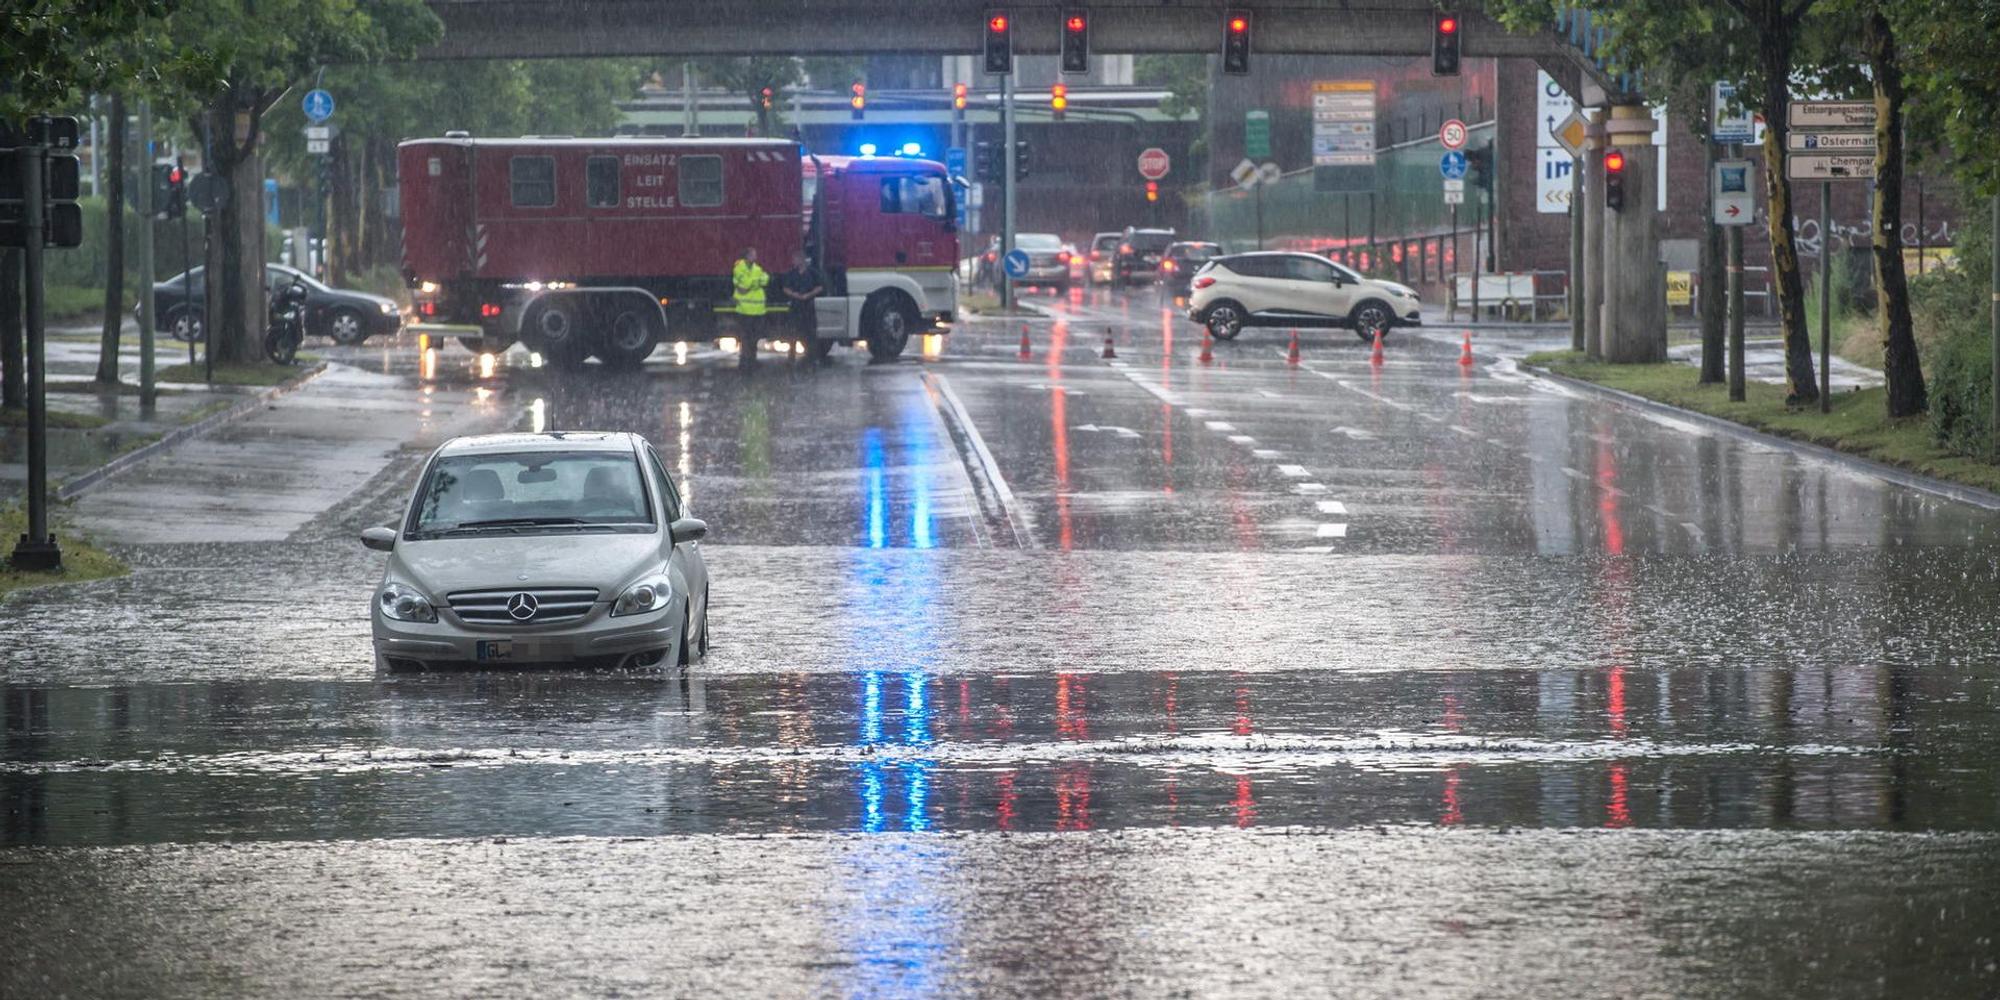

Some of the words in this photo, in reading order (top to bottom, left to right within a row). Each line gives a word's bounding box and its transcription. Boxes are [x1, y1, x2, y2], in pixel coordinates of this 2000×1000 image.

[1447, 128, 1461, 141] 50
[1820, 136, 1876, 146] Osterman
[624, 154, 677, 167] EINSATZ
[1140, 157, 1168, 170] STOP
[1830, 156, 1875, 168] Chempar
[636, 175, 665, 187] LEIT
[626, 196, 675, 208] STELLE
